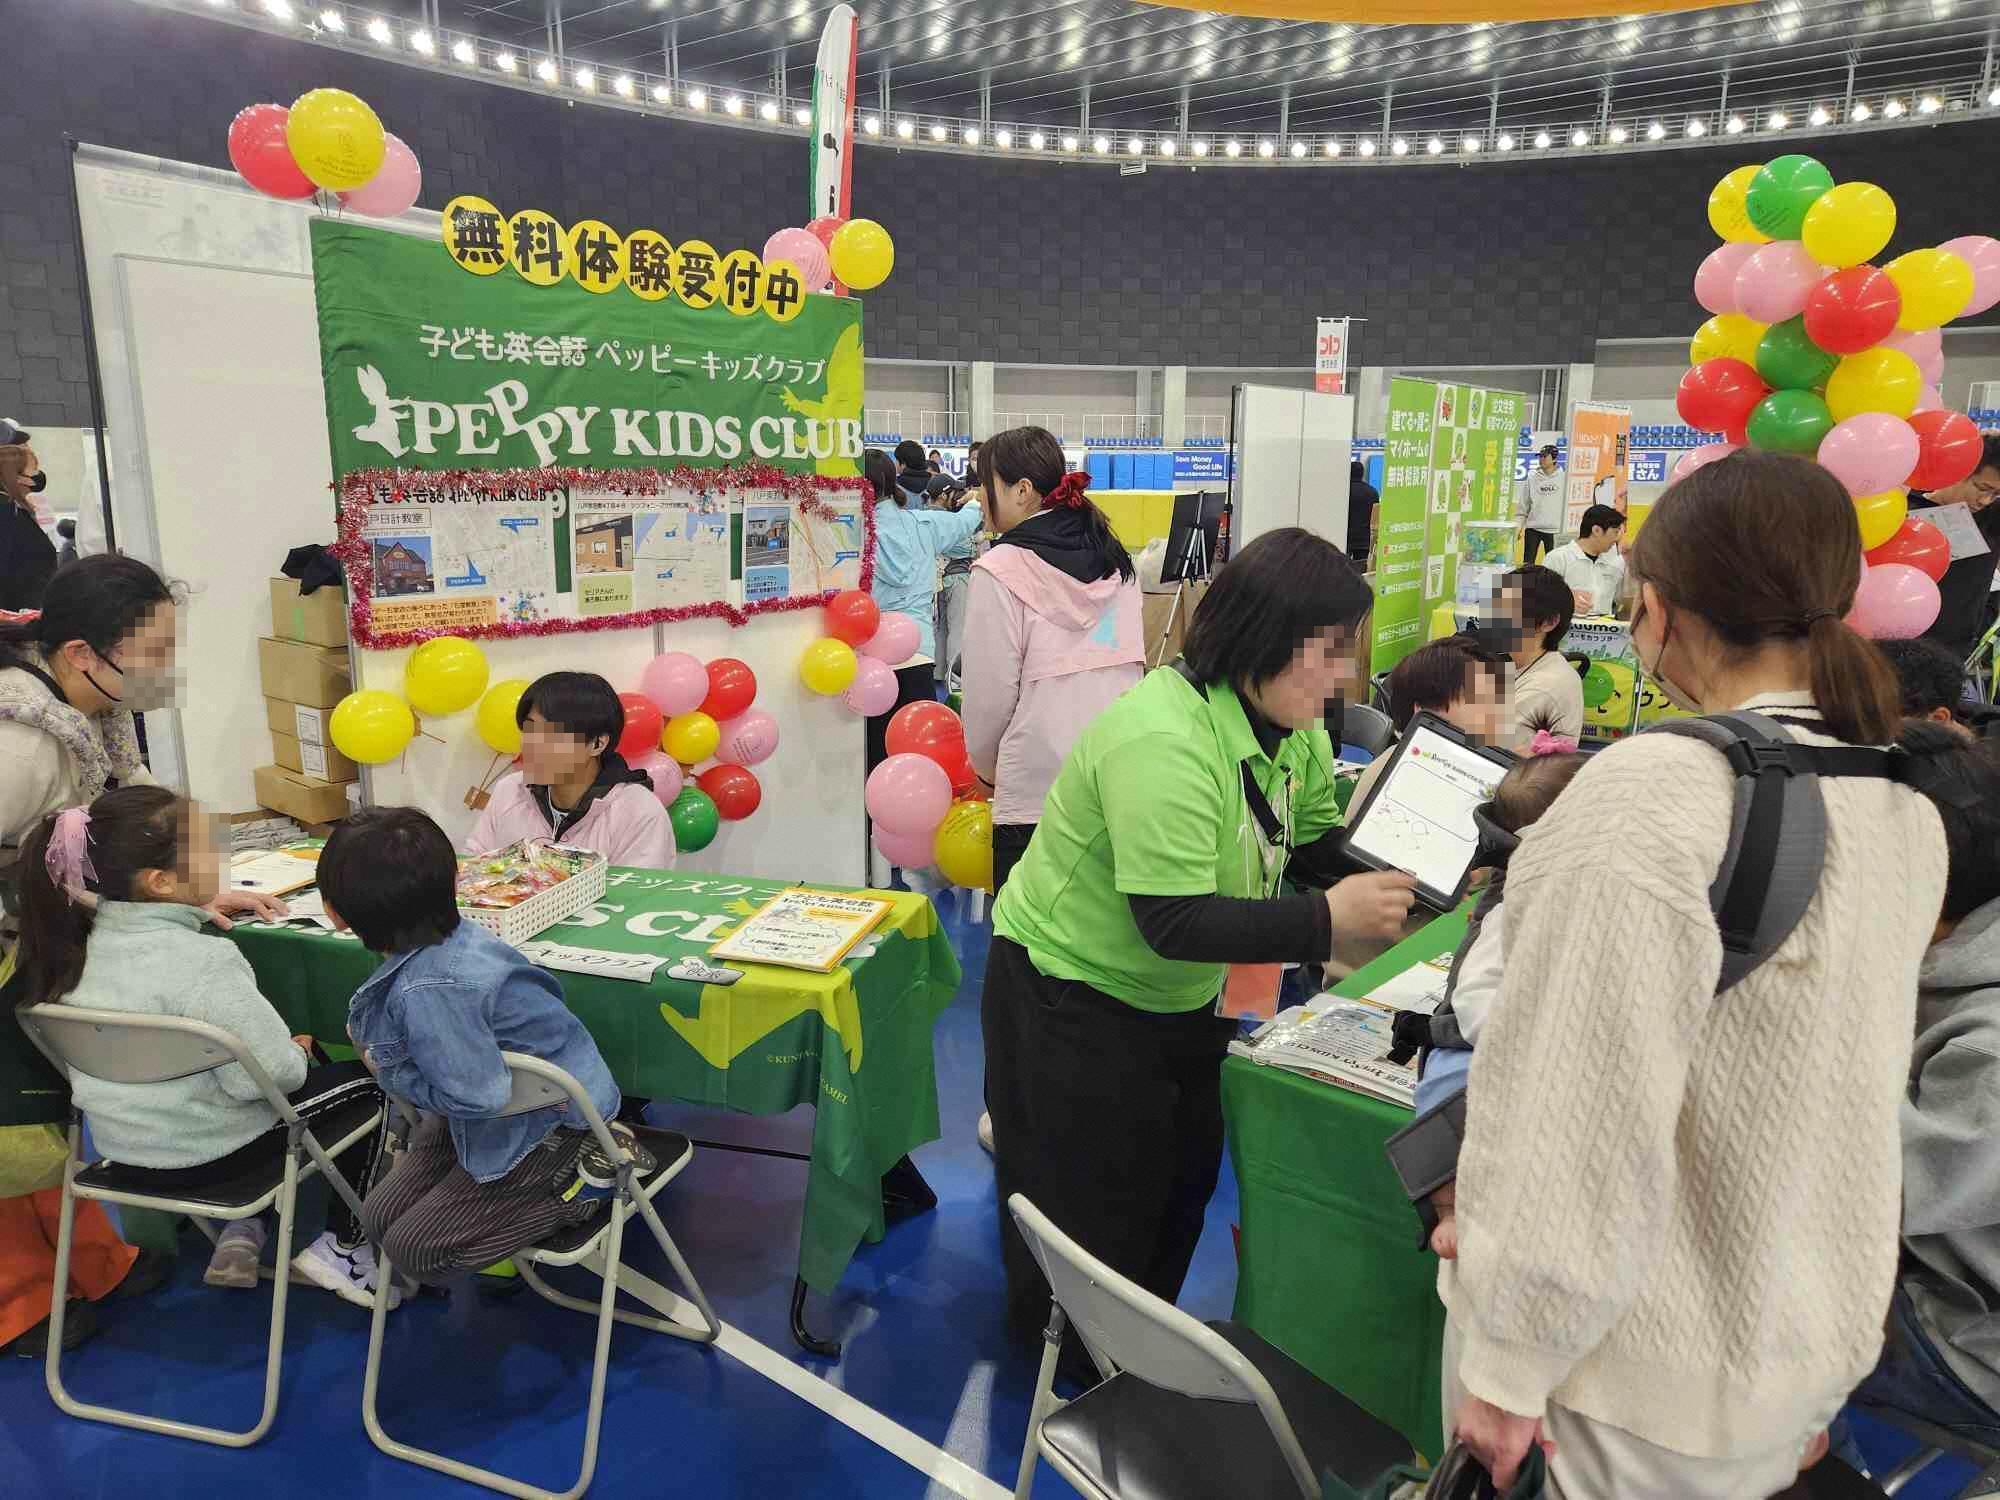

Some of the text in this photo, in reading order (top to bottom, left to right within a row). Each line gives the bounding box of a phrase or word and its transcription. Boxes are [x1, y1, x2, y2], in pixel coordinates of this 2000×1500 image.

[451, 206, 799, 317] 無料体験受付中
[419, 325, 826, 384] 子ども英会話 ペッピーキッズクラブ
[412, 380, 864, 467] PEPPY KIDS CLUB
[1569, 623, 1619, 634] uumo
